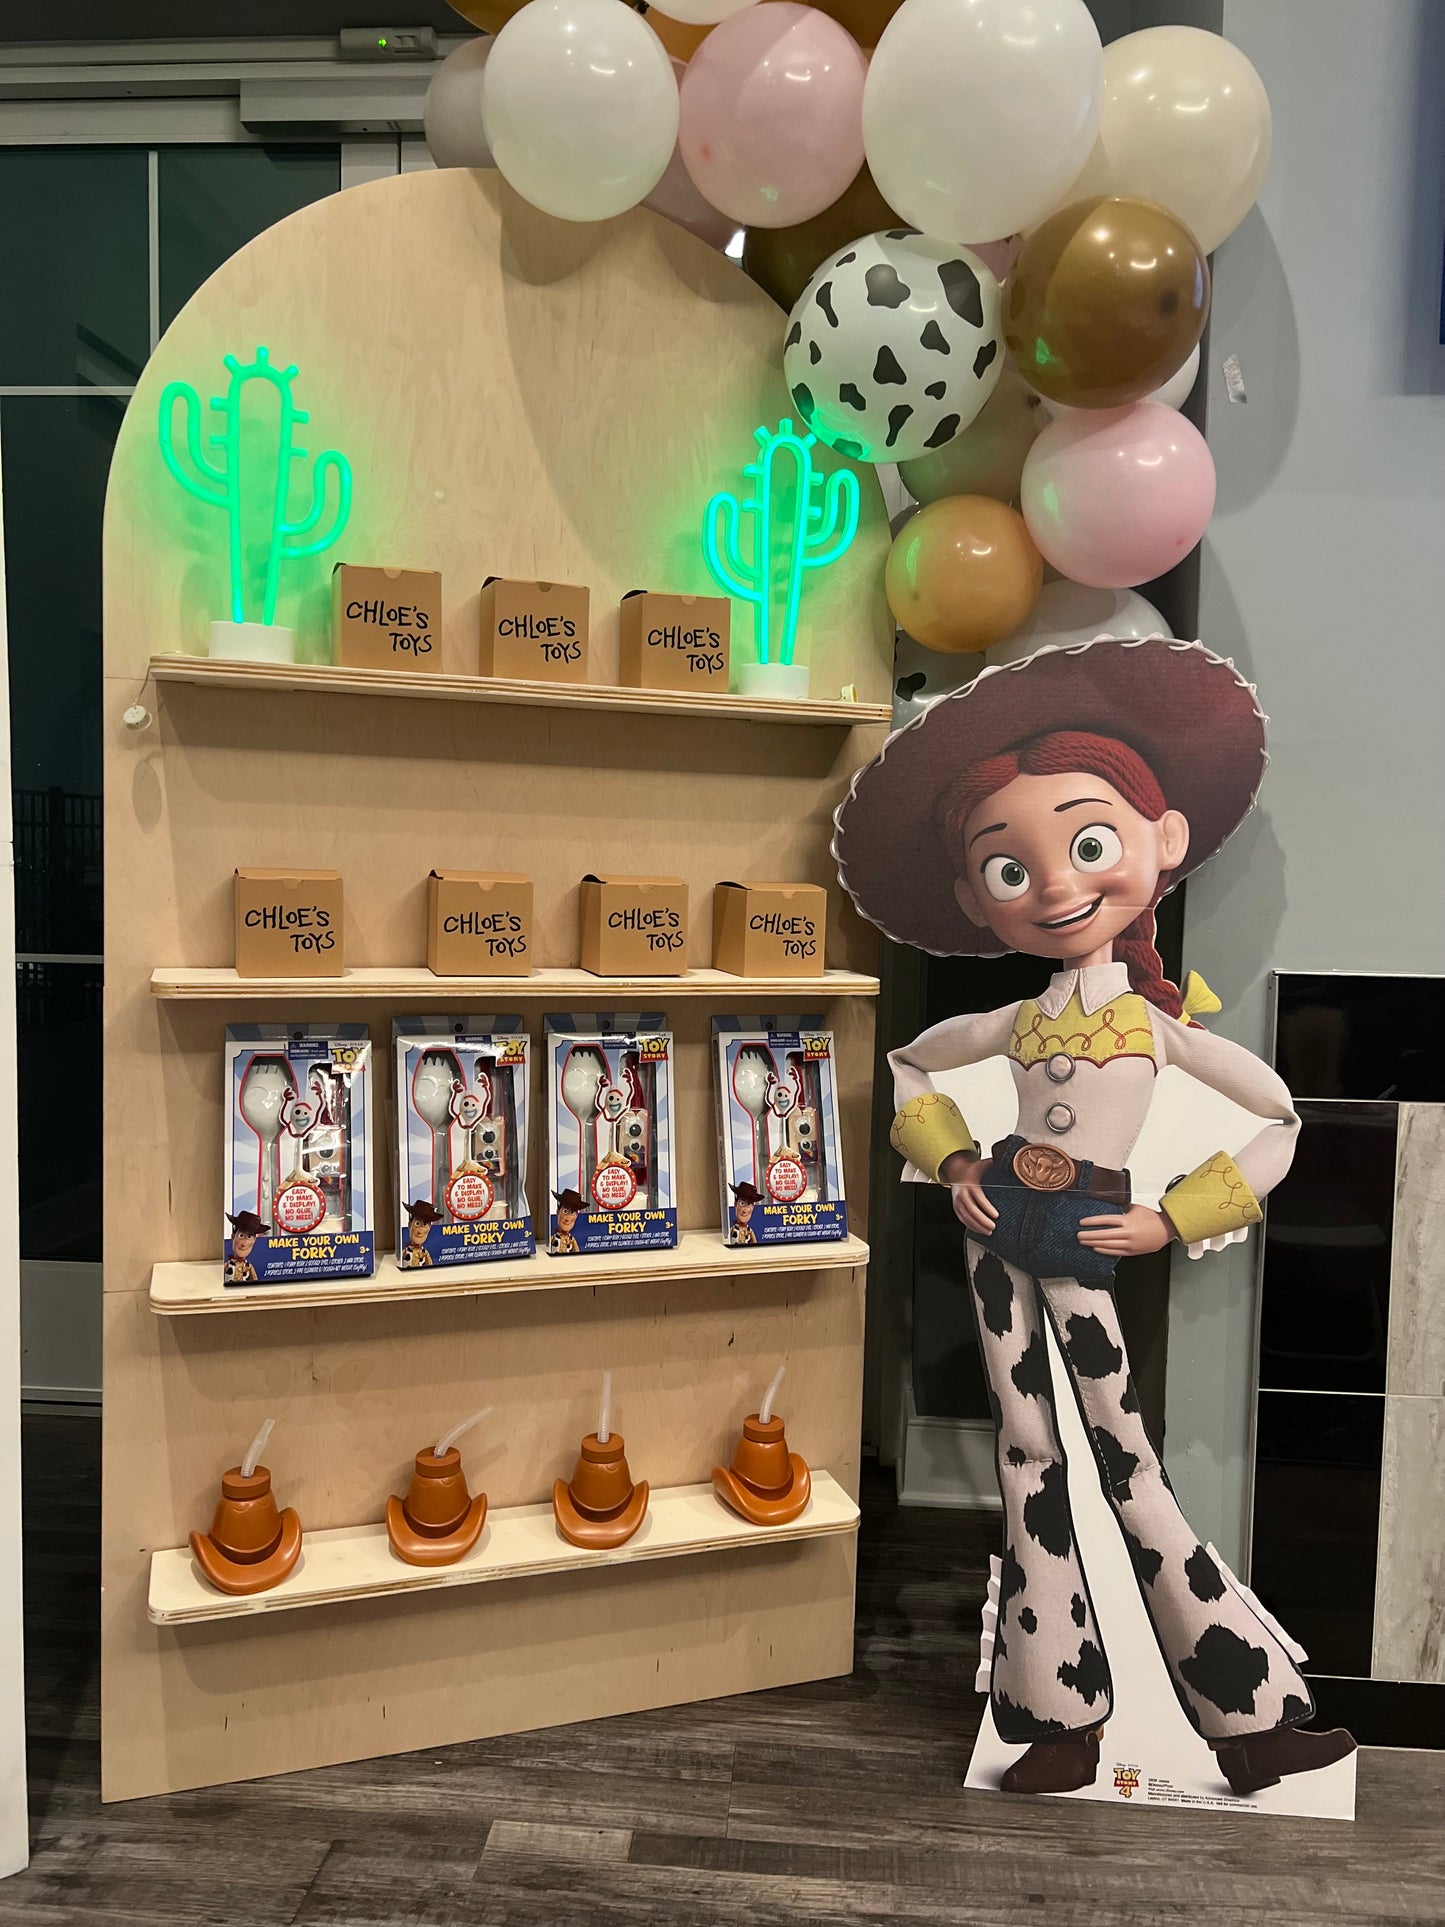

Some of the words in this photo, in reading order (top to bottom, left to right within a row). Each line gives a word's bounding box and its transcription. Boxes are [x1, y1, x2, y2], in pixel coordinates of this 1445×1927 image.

[347, 600, 429, 629] CHLOE'S
[498, 615, 575, 639] CHLOE'S
[648, 625, 720, 649] CHLOE'S
[389, 633, 432, 656] TOYS
[540, 641, 581, 664] TOYS
[686, 653, 724, 674] TOYS
[245, 905, 329, 930] CHLOE'S
[444, 911, 521, 935] CHLOE'S
[608, 908, 679, 930] CHLOE'S
[750, 913, 815, 936] CHLOE'S
[290, 931, 335, 954] TOYS
[485, 935, 526, 957] TOYS
[646, 931, 683, 952] TOYS
[783, 940, 816, 959] TOYS
[639, 1038, 670, 1052] TOY
[803, 1037, 831, 1051] TOY
[589, 1214, 614, 1223] MAKE
[617, 1212, 640, 1221] YOUR
[645, 1211, 665, 1219] OWN
[764, 1205, 787, 1215] MAKE
[790, 1204, 812, 1213] YOUR
[815, 1203, 834, 1211] OWN
[783, 1213, 817, 1225] FORKY
[443, 1225, 470, 1235] MAKE
[473, 1222, 499, 1232] YOUR
[503, 1220, 524, 1230] OWN
[608, 1221, 646, 1234] FORKY
[269, 1238, 298, 1248] MAKE
[303, 1236, 330, 1246] YOUR
[335, 1234, 359, 1244] OWN
[464, 1232, 504, 1245] FORKY
[292, 1246, 336, 1260] FORKY
[1114, 1768, 1141, 1780] TOY
[1119, 1786, 1132, 1798] 4
